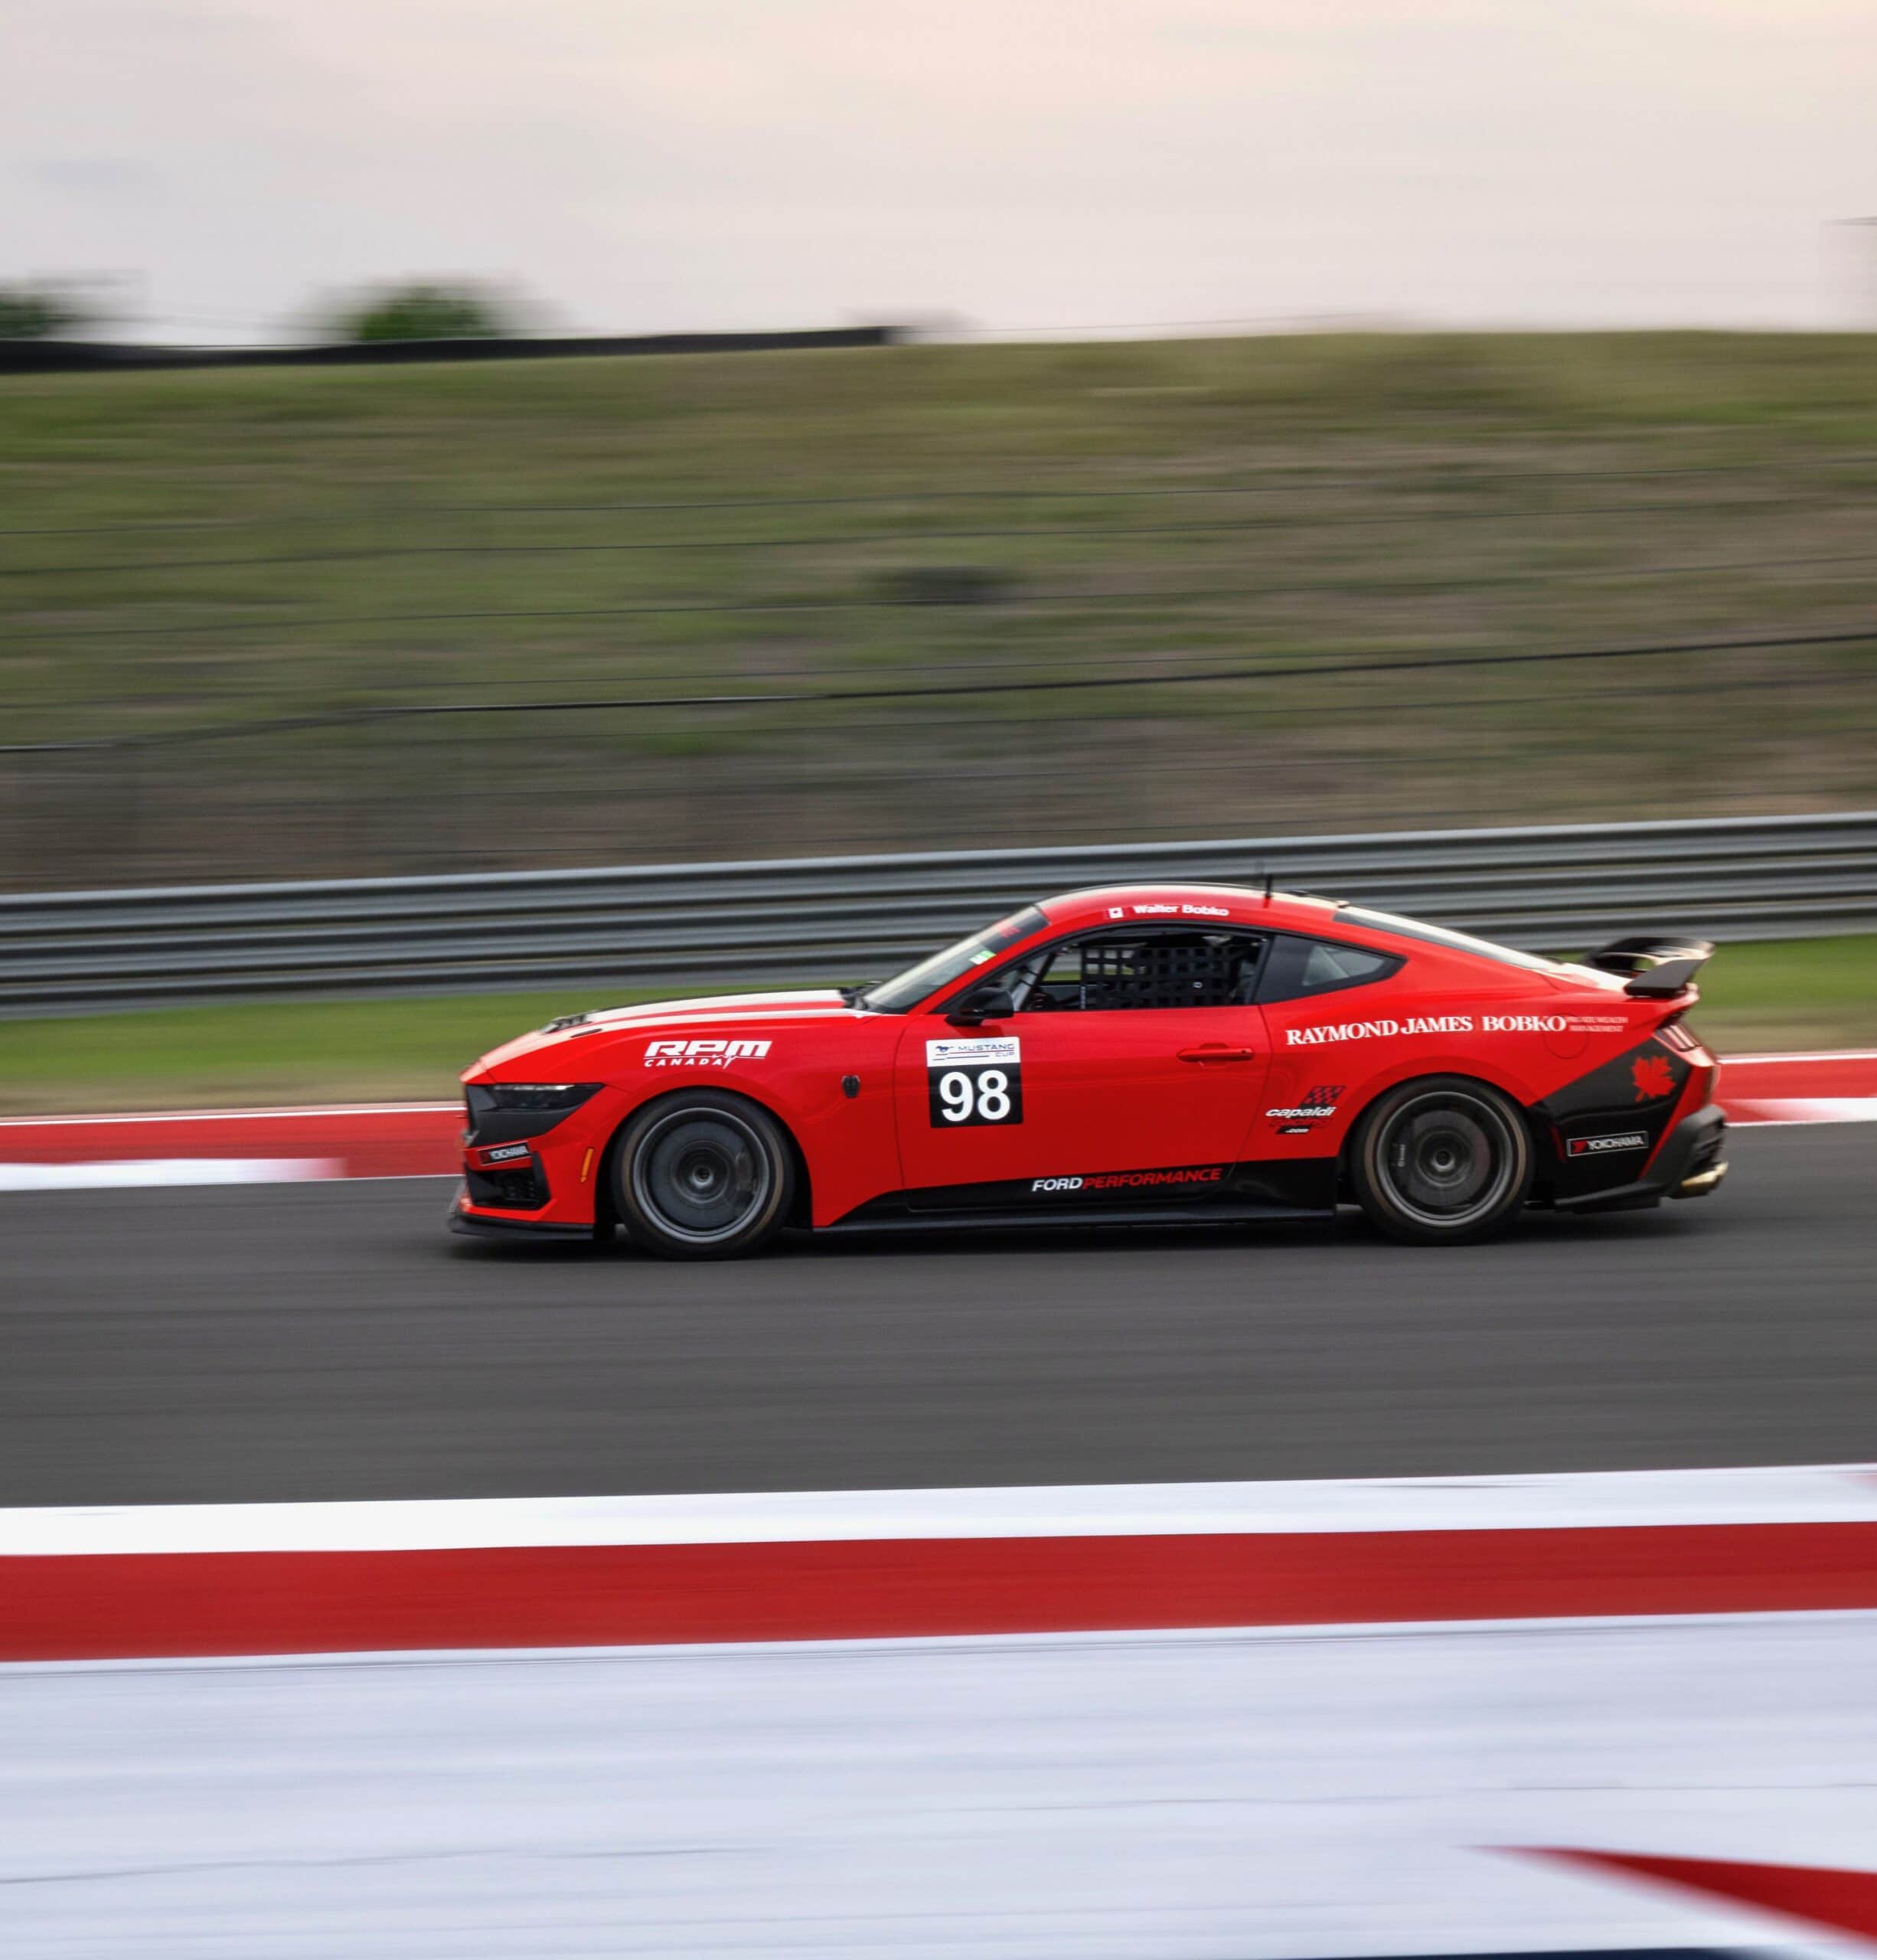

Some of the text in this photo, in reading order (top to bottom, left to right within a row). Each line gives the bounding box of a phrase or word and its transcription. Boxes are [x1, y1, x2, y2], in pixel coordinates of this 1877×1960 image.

[1132, 904, 1229, 916] Walter Bobko
[1286, 1016, 1566, 1045] RAYMOND JAMES BOBKO
[644, 1040, 772, 1057] RPM
[644, 1058, 723, 1067] CANADA
[939, 1070, 1010, 1122] 98
[1265, 1106, 1337, 1119] capaldi
